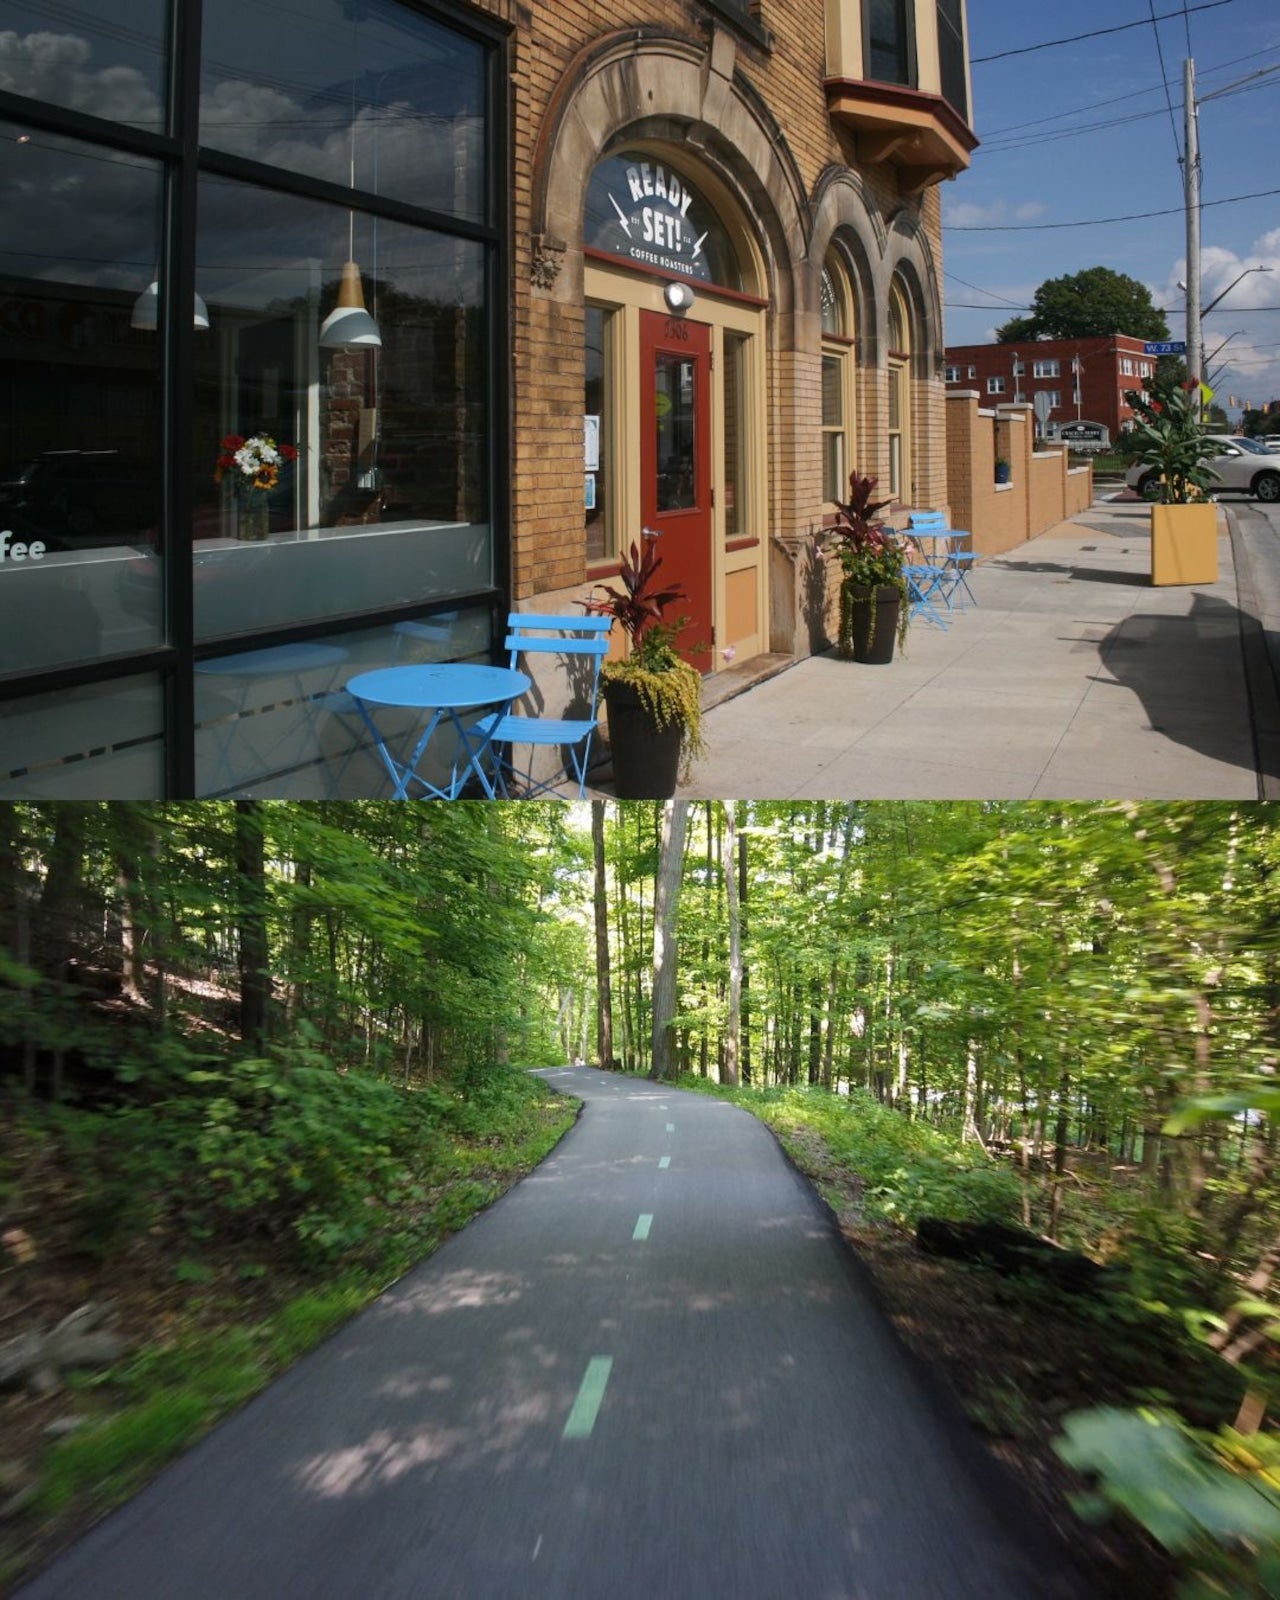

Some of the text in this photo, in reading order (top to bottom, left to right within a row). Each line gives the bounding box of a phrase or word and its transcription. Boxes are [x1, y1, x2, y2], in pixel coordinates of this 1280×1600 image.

[626, 163, 693, 218] READY
[642, 206, 682, 252] SET!
[630, 247, 693, 275] COFFEE ROASTERS
[1160, 344, 1171, 352] 73
